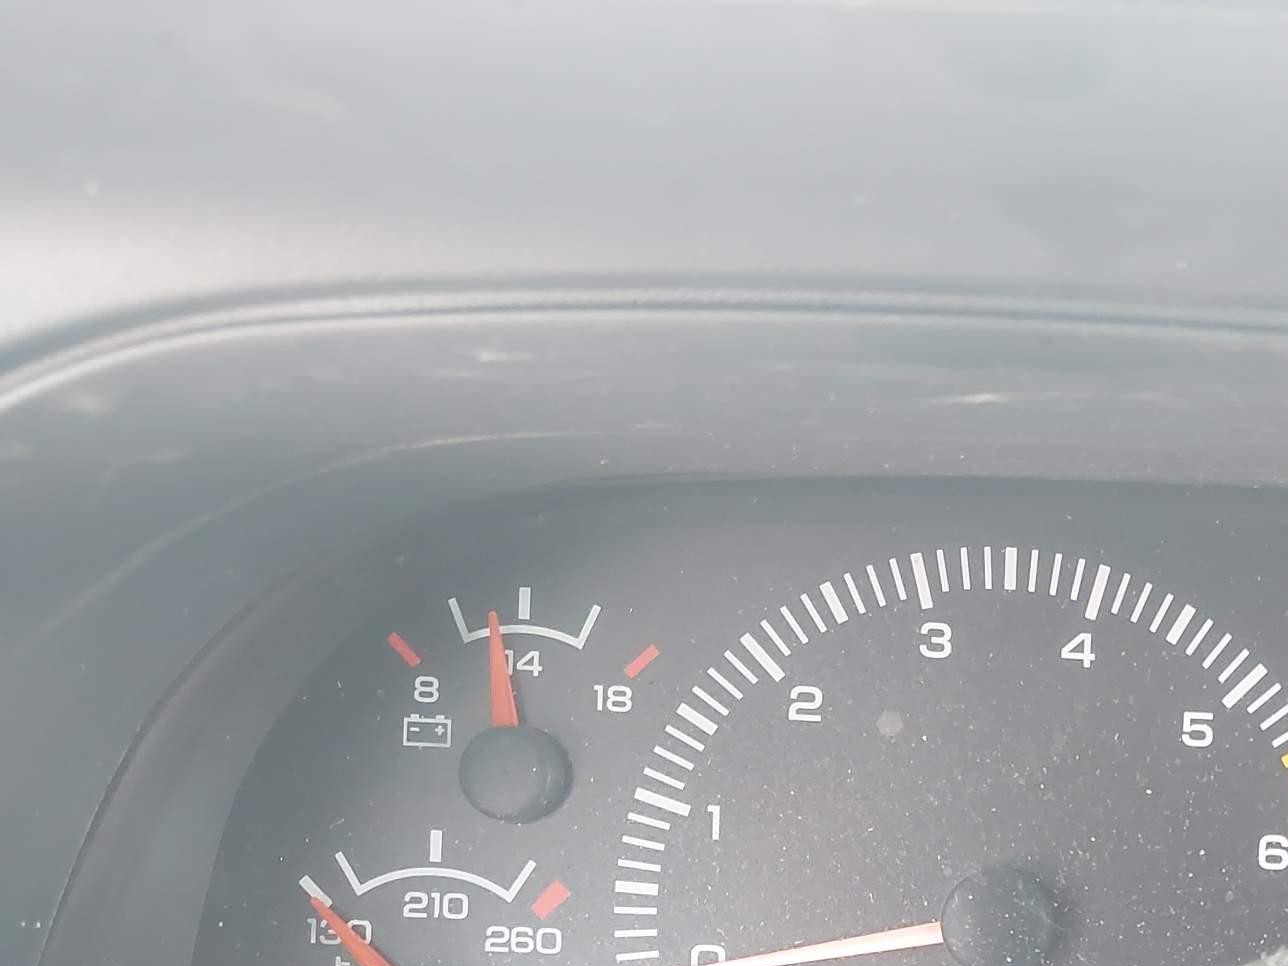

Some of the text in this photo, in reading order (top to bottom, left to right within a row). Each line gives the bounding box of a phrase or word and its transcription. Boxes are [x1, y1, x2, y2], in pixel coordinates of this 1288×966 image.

[918, 622, 953, 658] 3
[1060, 632, 1096, 668] 4
[504, 650, 543, 677] 14
[413, 675, 440, 703] 8
[593, 684, 633, 713] 18
[788, 685, 823, 722] 2
[1181, 711, 1214, 747] 5
[707, 804, 720, 841] 1
[402, 892, 468, 919] 210
[484, 927, 562, 954] 260
